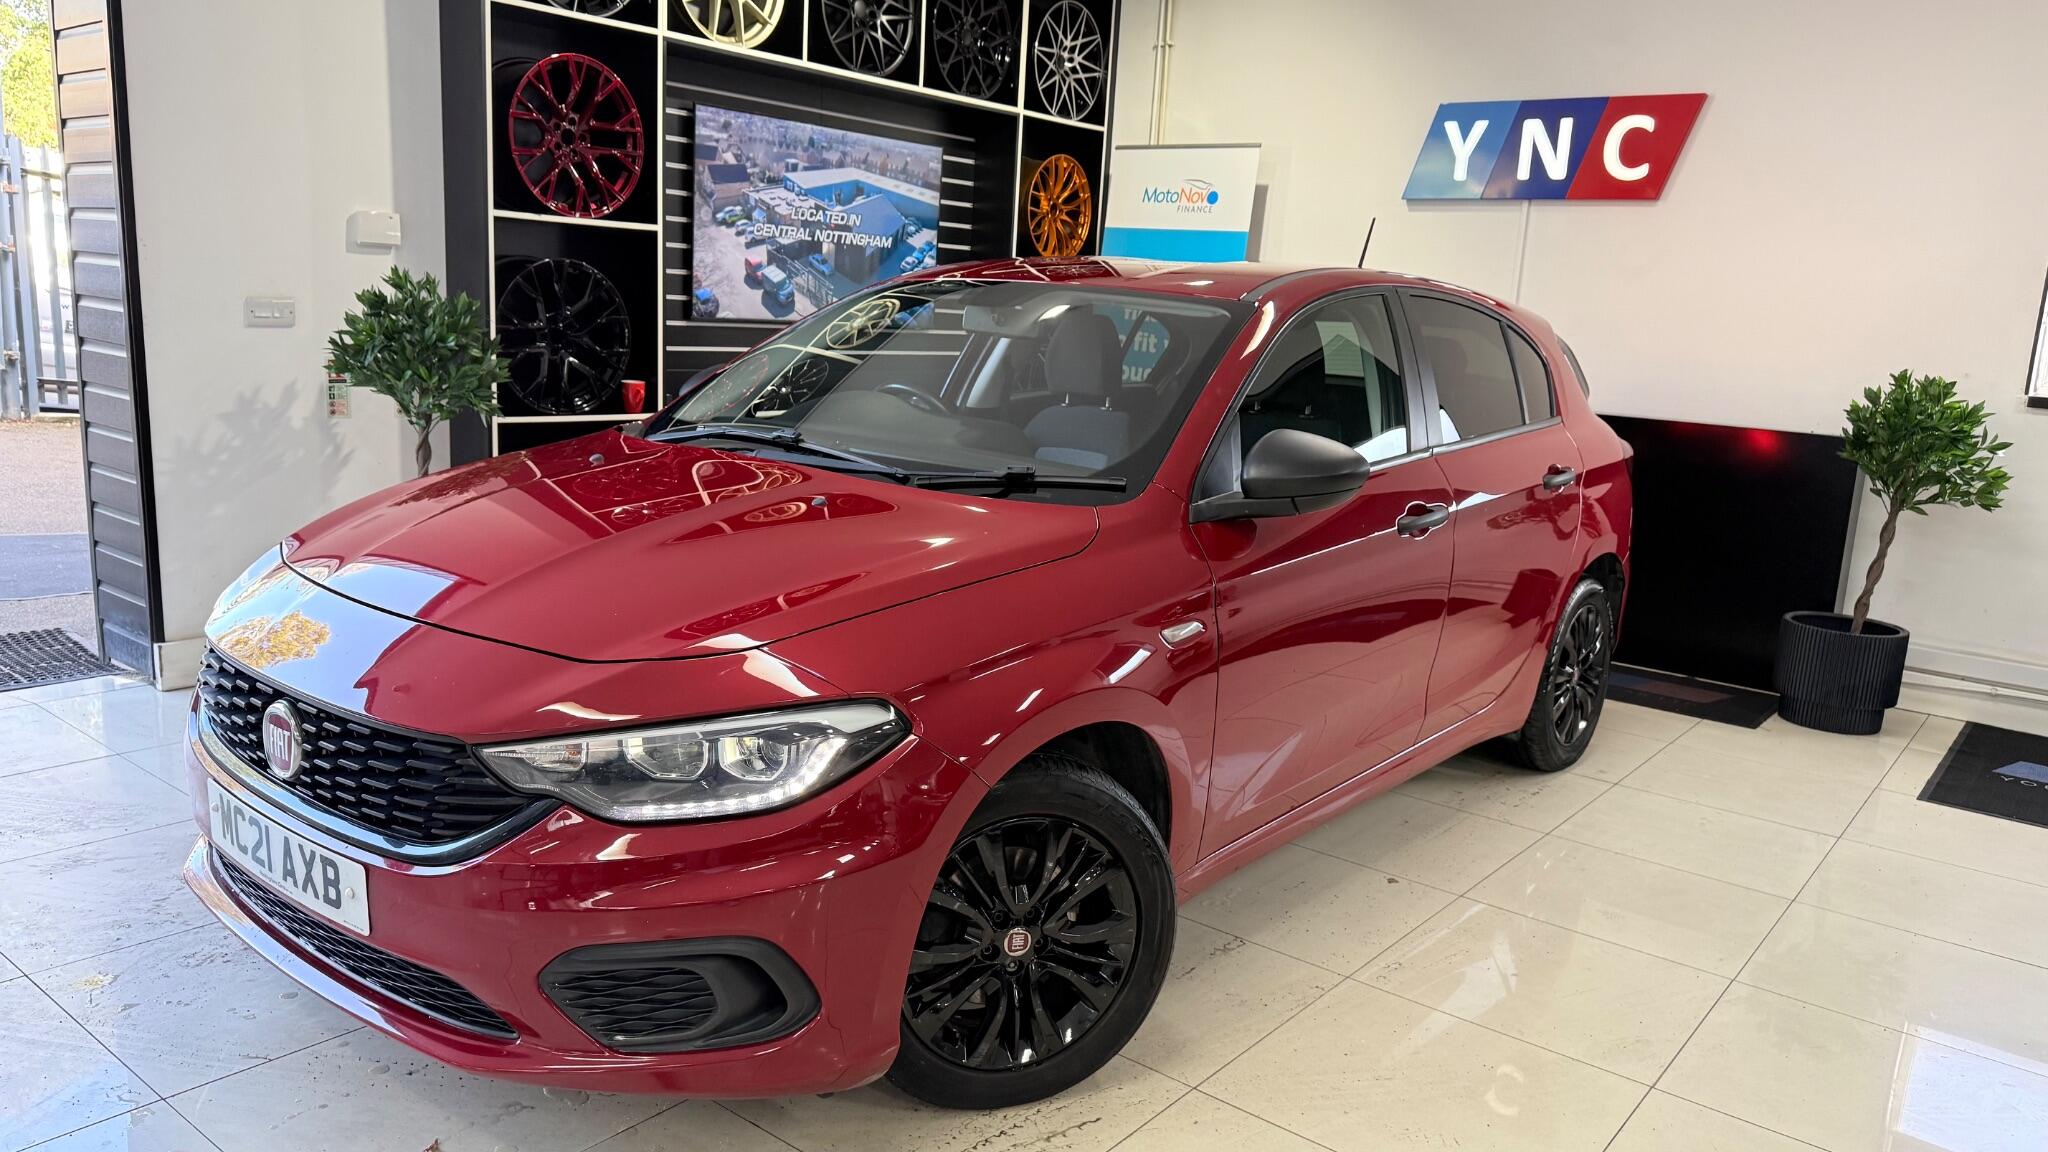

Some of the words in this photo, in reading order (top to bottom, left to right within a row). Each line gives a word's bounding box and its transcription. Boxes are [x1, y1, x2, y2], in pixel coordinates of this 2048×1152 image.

[1443, 114, 1655, 182] YNC
[791, 207, 847, 224] LOCATED
[849, 213, 862, 226] IN
[1177, 205, 1213, 214] FINANCE
[753, 223, 812, 240] CENTRAL
[814, 229, 893, 249] NOTTINGHAM
[269, 723, 291, 761] FIAT
[219, 793, 273, 874] MC21
[282, 836, 342, 910] AXB
[1011, 933, 1025, 950] FIAT
